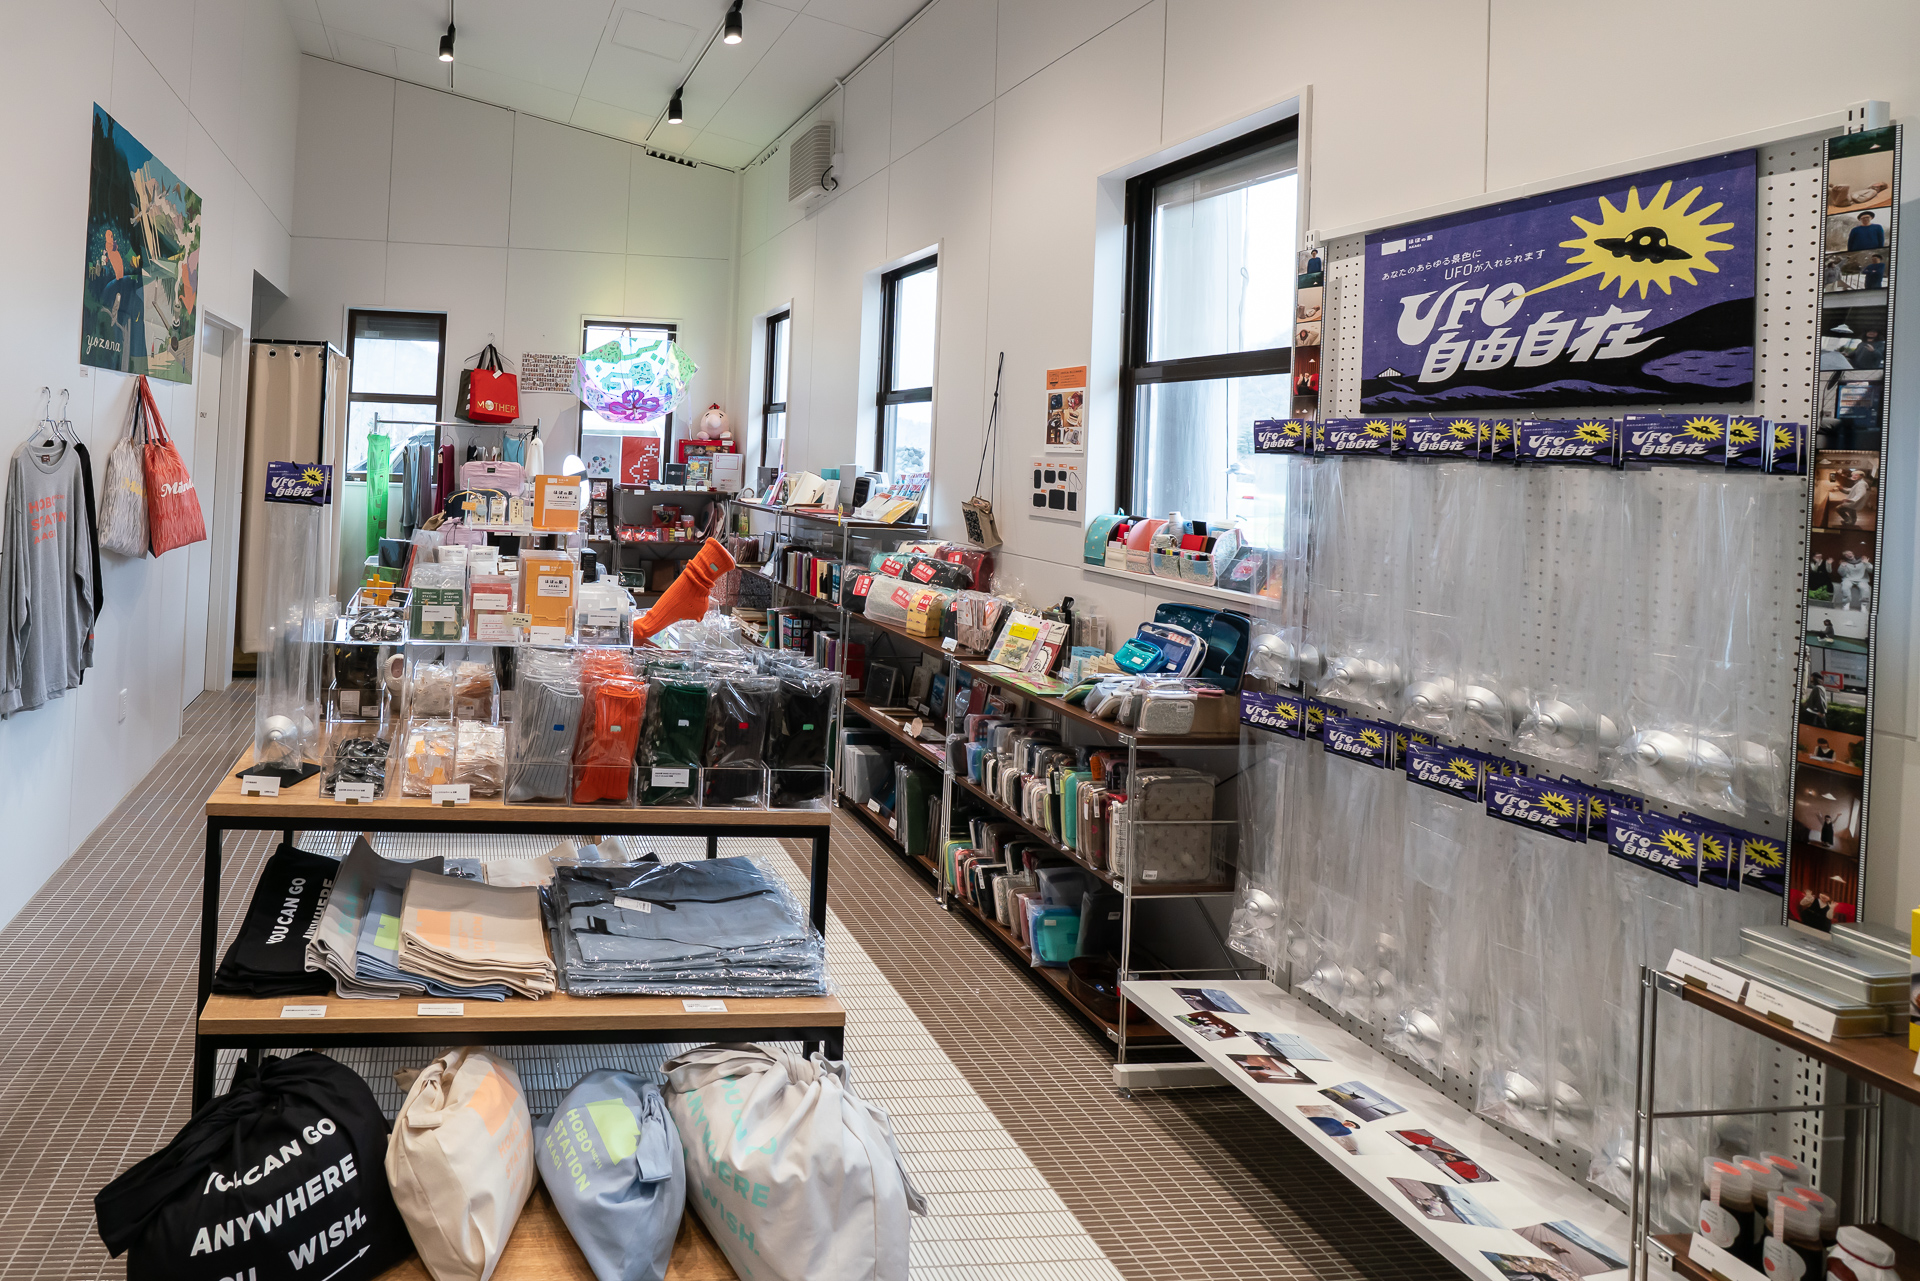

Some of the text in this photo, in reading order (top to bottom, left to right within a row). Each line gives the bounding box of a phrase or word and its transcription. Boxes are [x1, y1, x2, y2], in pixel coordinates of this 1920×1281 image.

[1381, 250, 1482, 281] あなたのあらゆる景色に
[1444, 249, 1546, 280] UFOが入れられます
[1397, 281, 1526, 346] UFO
[86, 334, 121, 355] yozora
[1418, 304, 1665, 383] 自由自在
[477, 399, 516, 414] MOTHER
[1258, 432, 1279, 442] UFO
[1330, 431, 1359, 442] UFO
[1412, 430, 1442, 444] UFO
[1528, 435, 1566, 448] UFO
[1632, 430, 1673, 446] UFO
[272, 476, 296, 488] UFO
[33, 530, 56, 545] AAGI
[1246, 704, 1270, 716] UFO
[1328, 729, 1354, 744] UFO
[1412, 758, 1442, 774] UFO
[1494, 791, 1530, 808] UFO
[1615, 826, 1651, 848] UFO
[265, 878, 306, 944] YOU CAN GO
[241, 1139, 303, 1186] CAN
[302, 1117, 337, 1145] GO
[545, 1135, 562, 1171] AKAGI
[554, 1119, 590, 1192] STATION
[190, 1153, 358, 1257] ANYWHERE
[700, 1181, 760, 1256] WISH.
[288, 1207, 368, 1271] WISH.
